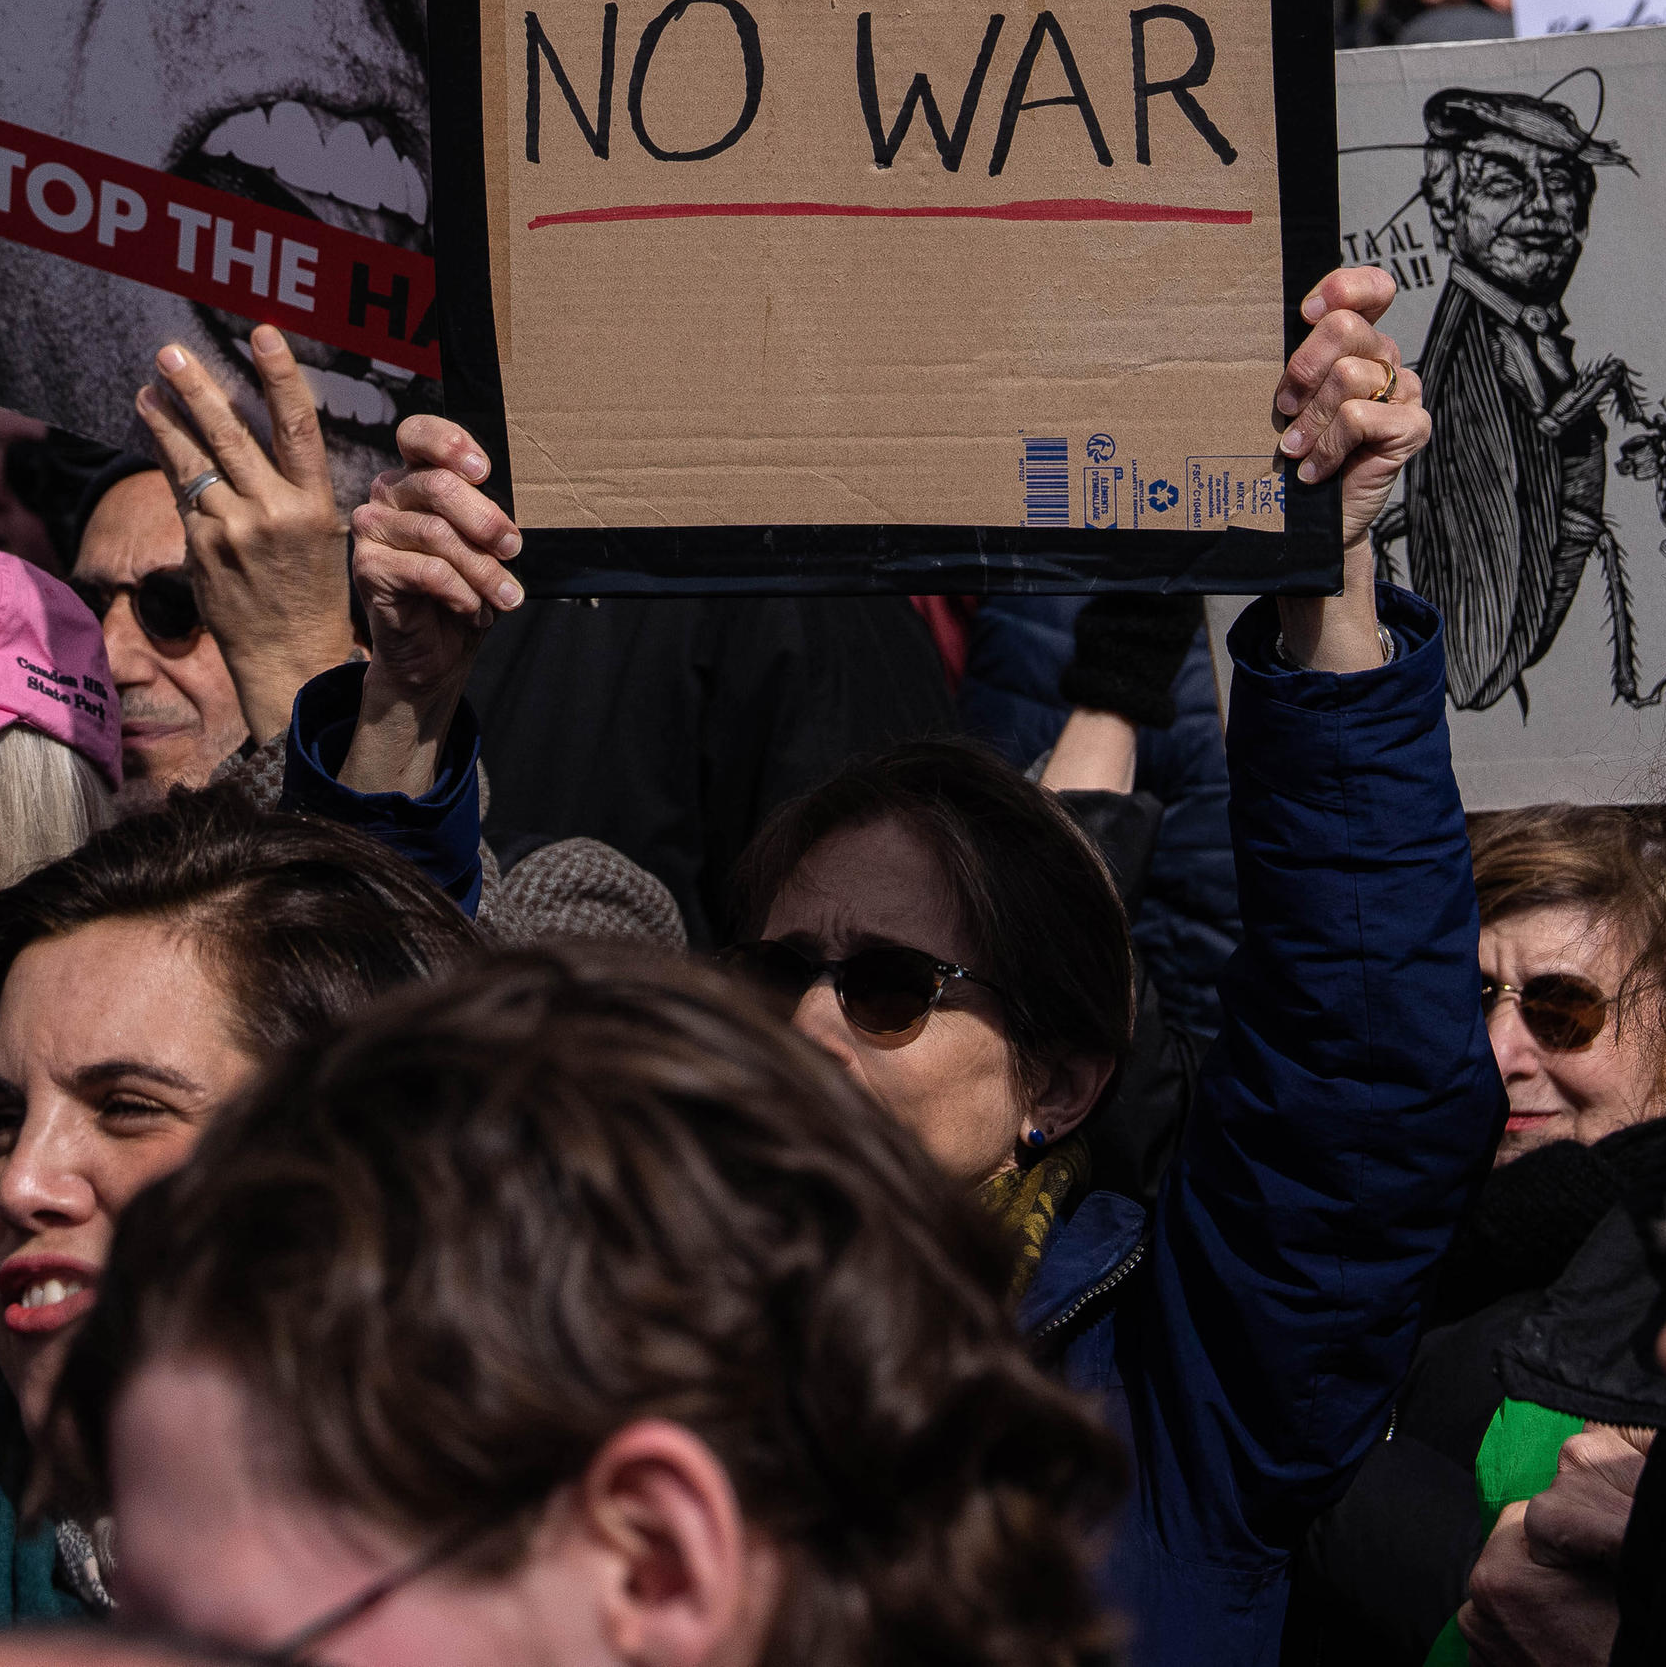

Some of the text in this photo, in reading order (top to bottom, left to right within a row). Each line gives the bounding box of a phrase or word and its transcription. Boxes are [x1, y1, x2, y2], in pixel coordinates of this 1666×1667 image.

[855, 2, 1239, 177] WAR
[167, 201, 319, 313] THE
[1193, 489, 1202, 529] C104831
[1259, 478, 1272, 514] FSC
